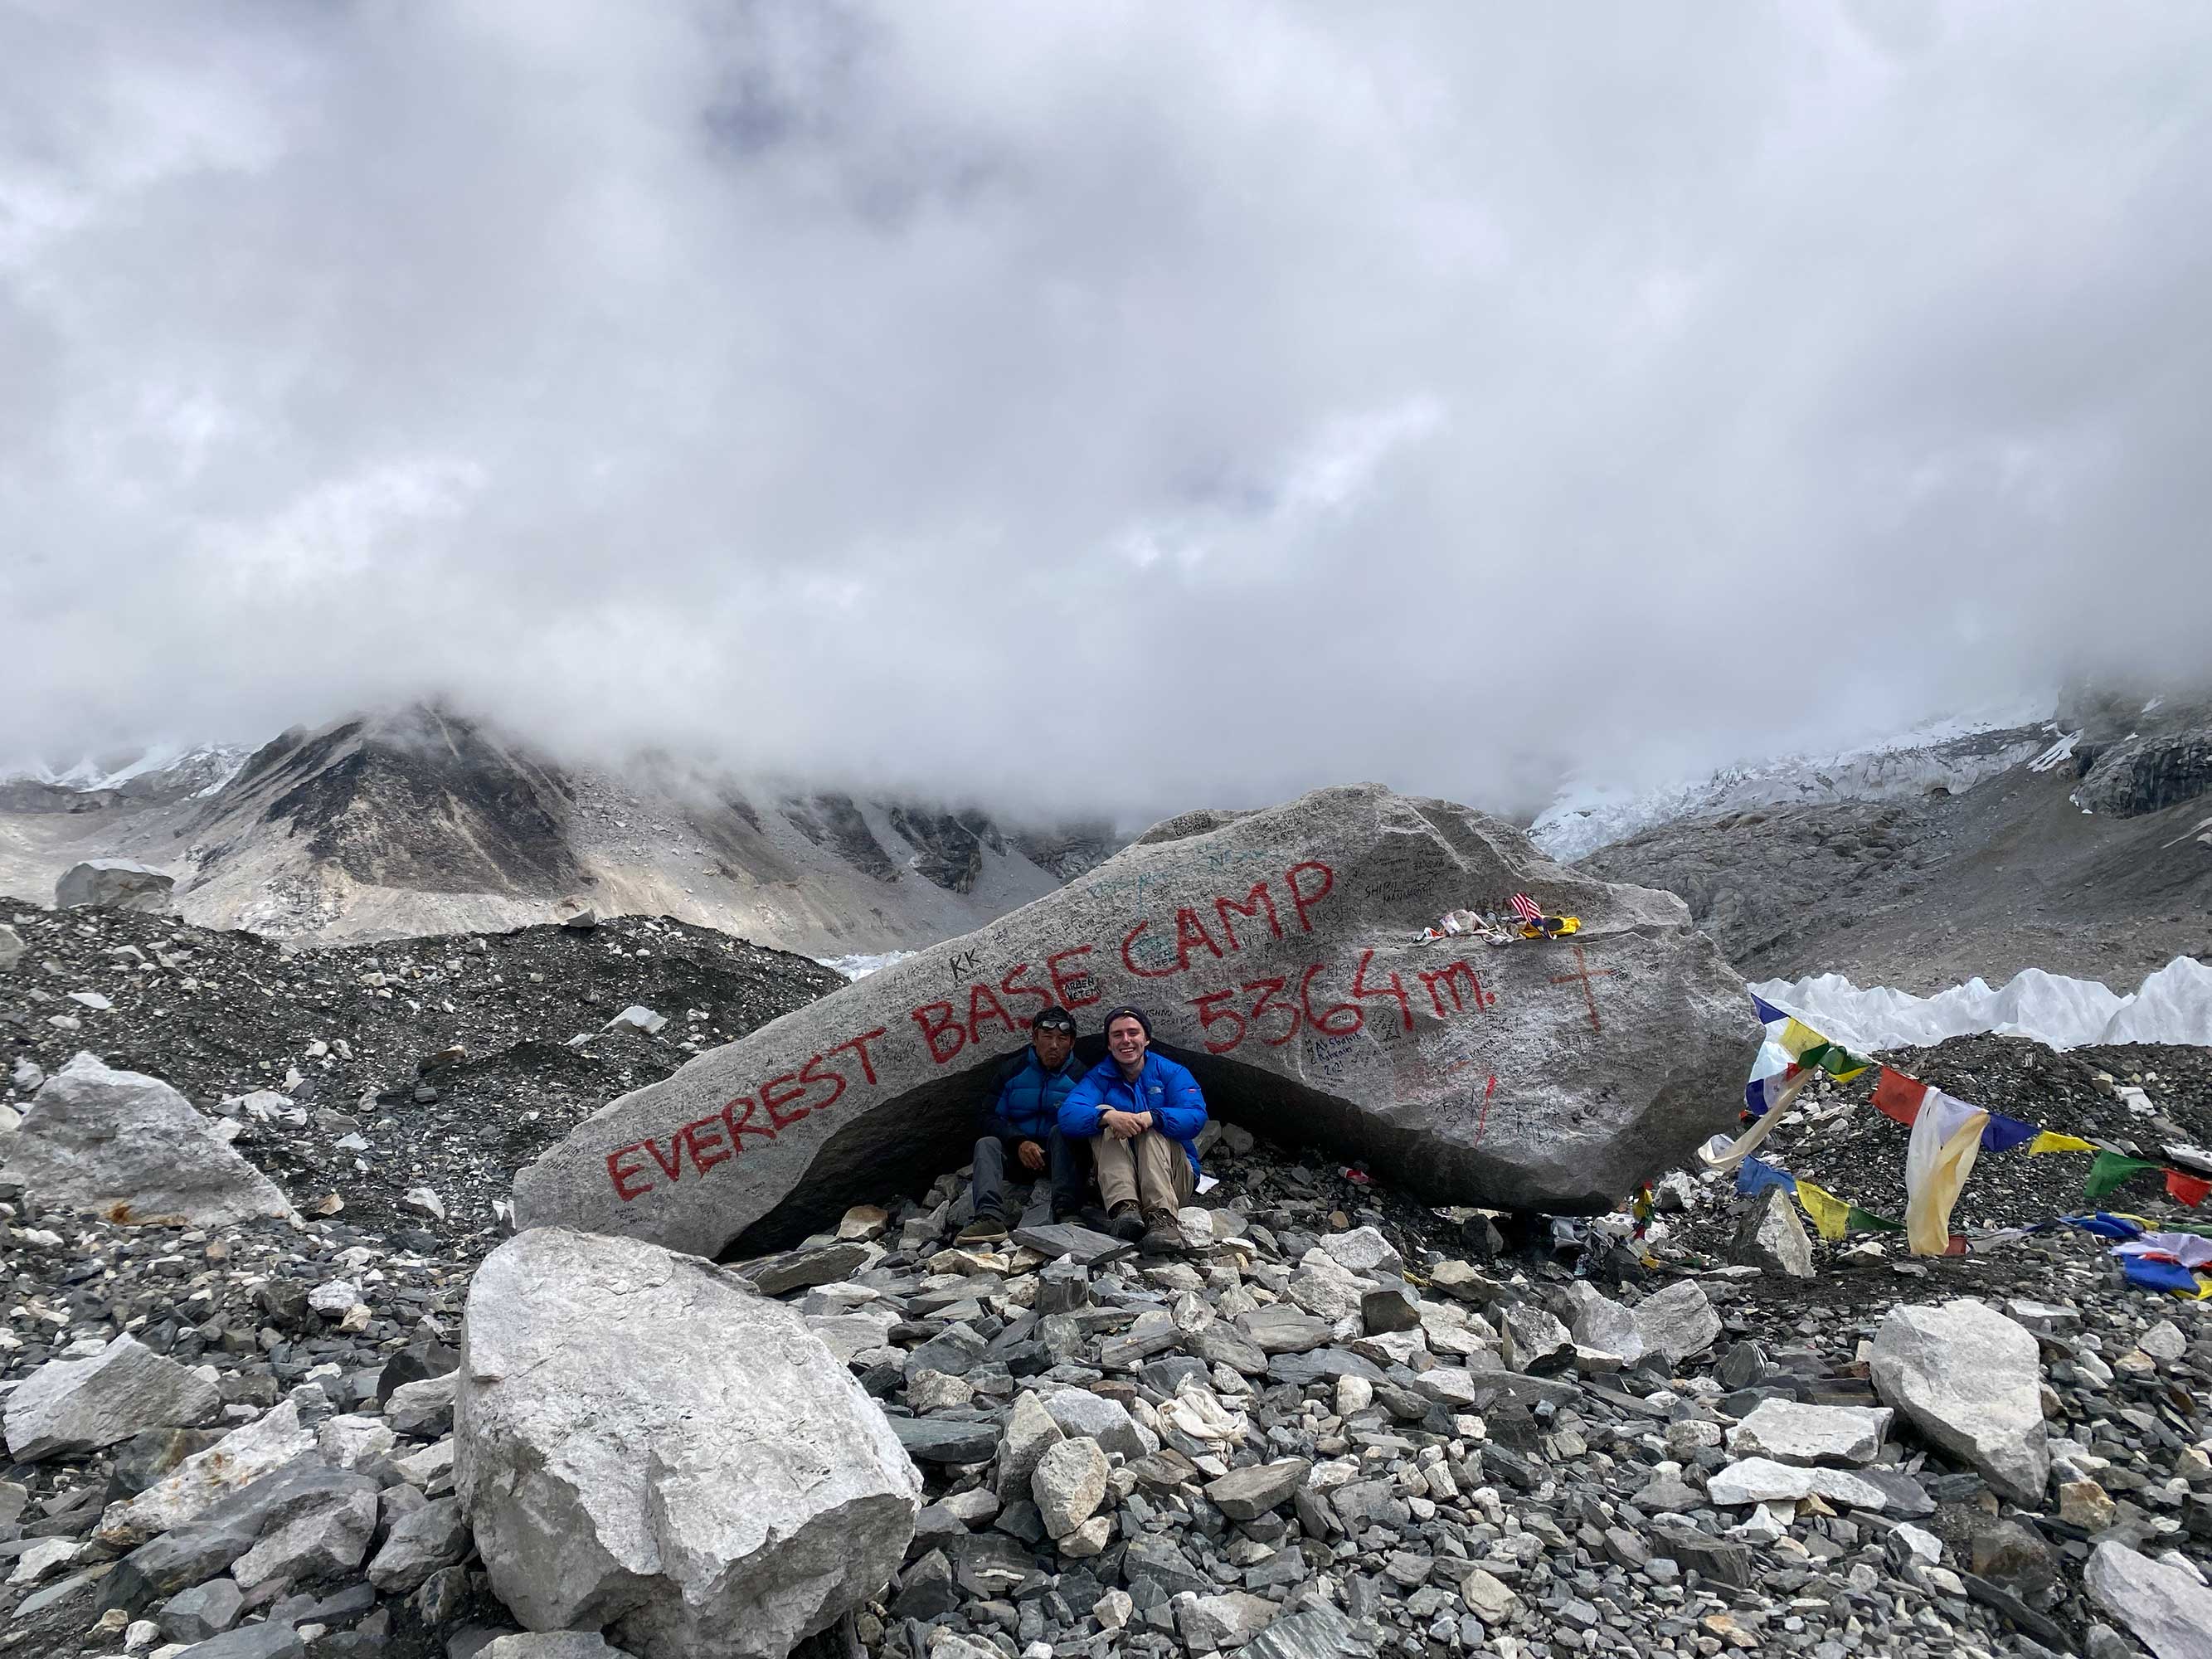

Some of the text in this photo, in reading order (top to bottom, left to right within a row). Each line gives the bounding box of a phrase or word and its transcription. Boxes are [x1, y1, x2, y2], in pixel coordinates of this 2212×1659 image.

[605, 861, 1334, 1202] EVEREST BASE CAMP
[949, 947, 982, 980] KK
